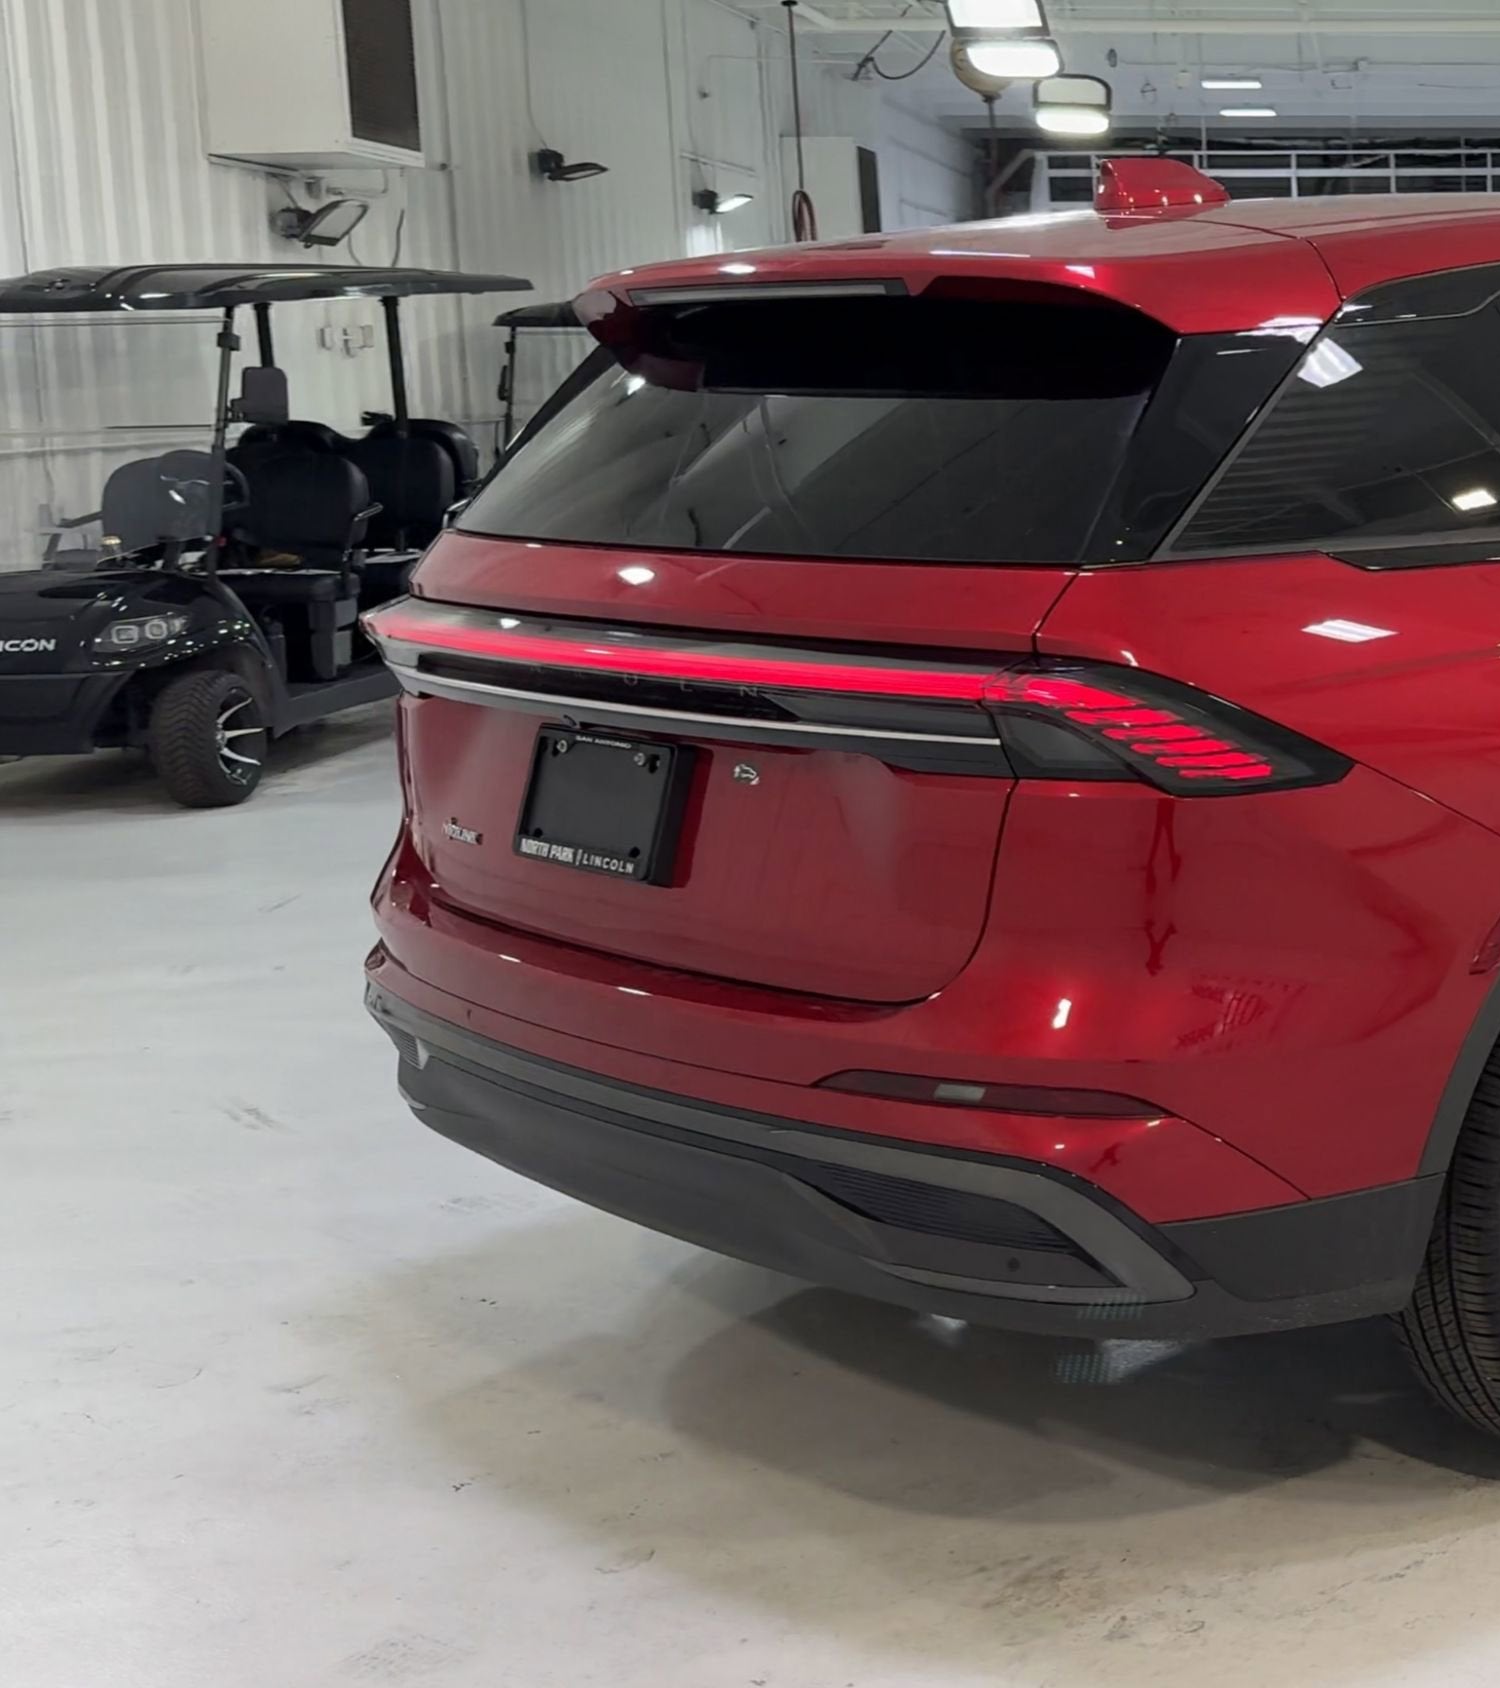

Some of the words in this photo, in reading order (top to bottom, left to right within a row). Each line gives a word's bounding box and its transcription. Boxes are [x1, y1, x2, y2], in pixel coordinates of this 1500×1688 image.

[520, 838, 550, 857] NORTH
[549, 844, 575, 863] PARK
[582, 853, 634, 874] LINCOLN
